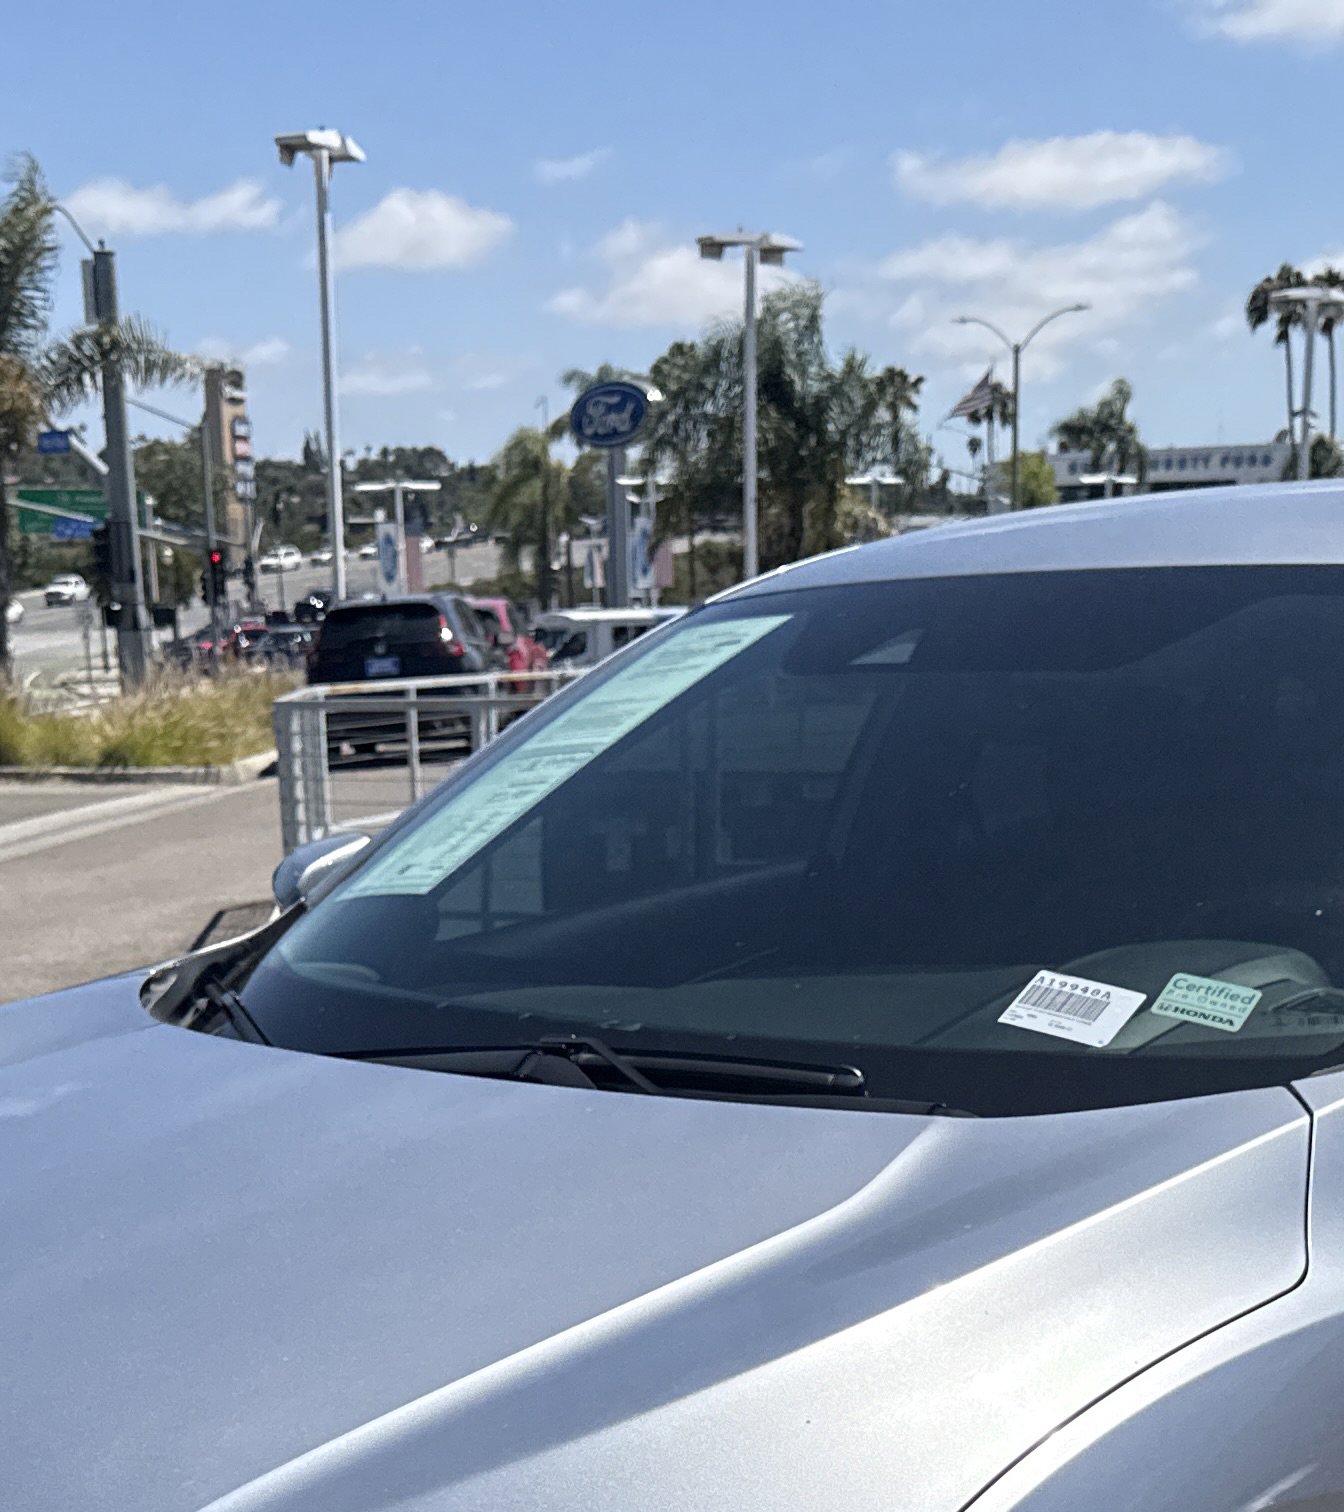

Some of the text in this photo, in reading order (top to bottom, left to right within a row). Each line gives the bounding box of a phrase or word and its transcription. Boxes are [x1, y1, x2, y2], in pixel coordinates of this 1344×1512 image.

[581, 393, 636, 436] Ford
[1172, 978, 1256, 1005] Certified
[1172, 1006, 1234, 1027] HONDA
